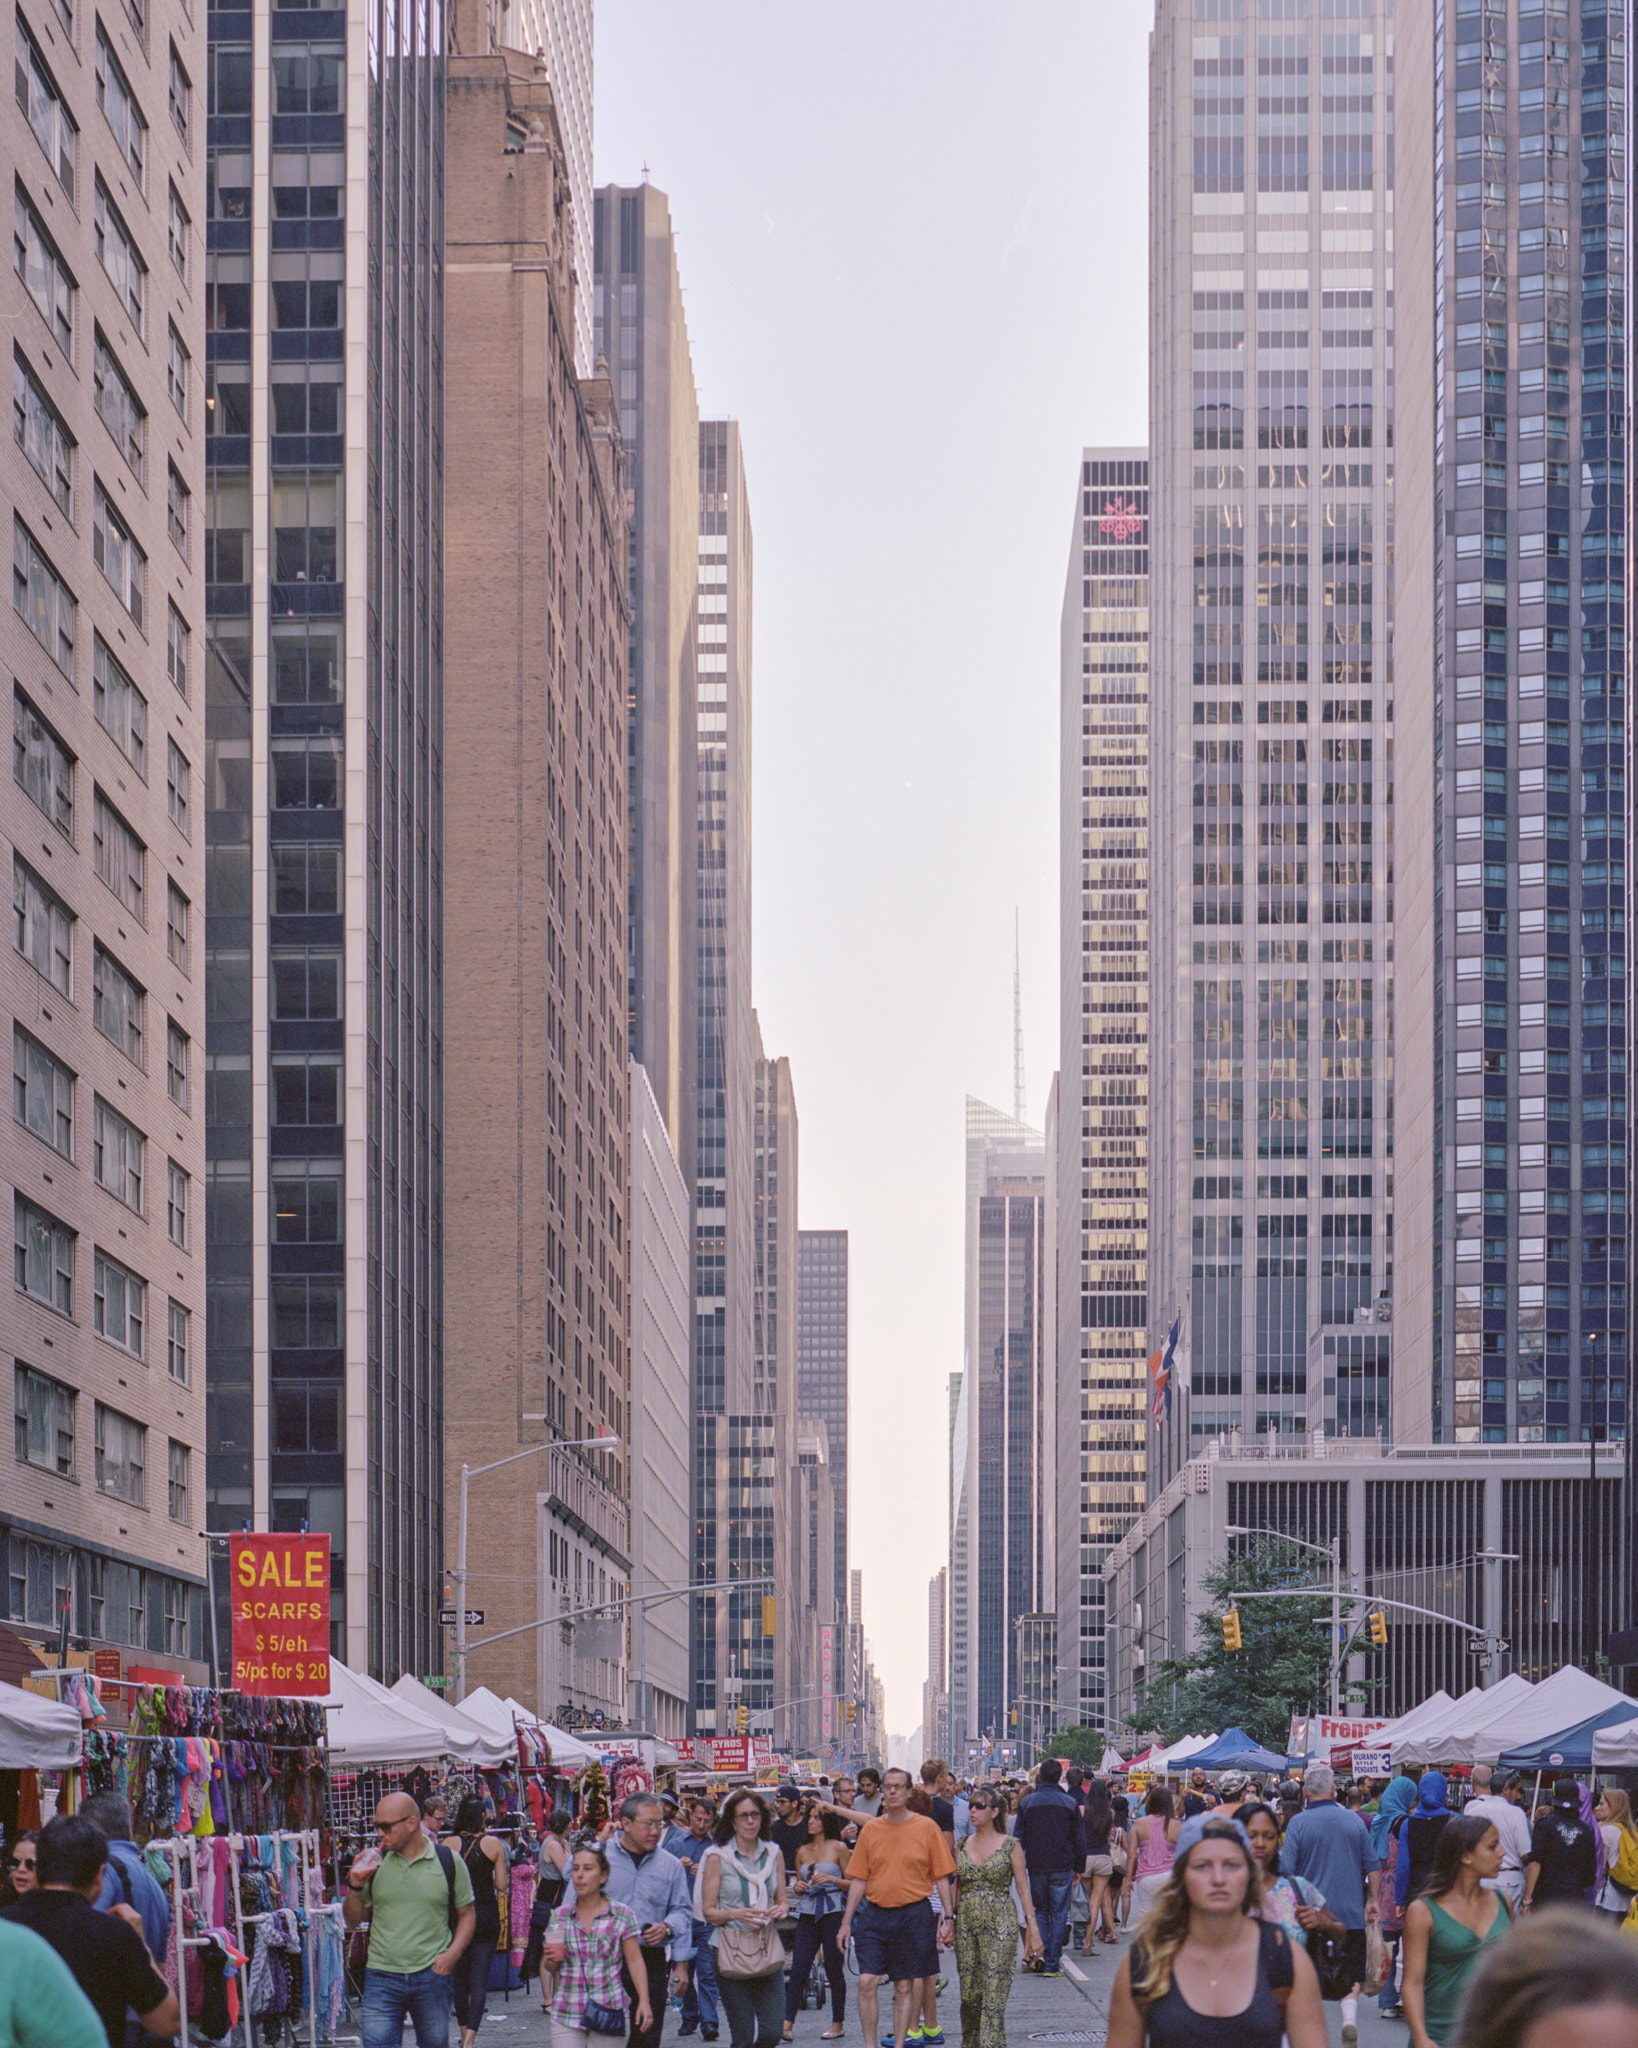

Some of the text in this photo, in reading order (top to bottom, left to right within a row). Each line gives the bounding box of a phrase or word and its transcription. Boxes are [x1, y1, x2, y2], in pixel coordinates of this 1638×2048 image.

[238, 1550, 324, 1587] SALE
[241, 1602, 322, 1620] SCARFS
[269, 1634, 308, 1652] 5/eh
[236, 1661, 269, 1683] 5/pc
[271, 1662, 293, 1680] for
[308, 1663, 328, 1680] 20
[431, 1677, 440, 1686] 55
[823, 1630, 832, 1733] RADIO CITY
[711, 1739, 743, 1749] GYROS
[723, 1749, 745, 1757] KEBAB
[1353, 1753, 1378, 1761] MURANO
[1354, 1766, 1379, 1774] PENDANTS
[1129, 1781, 1137, 1793] 2
